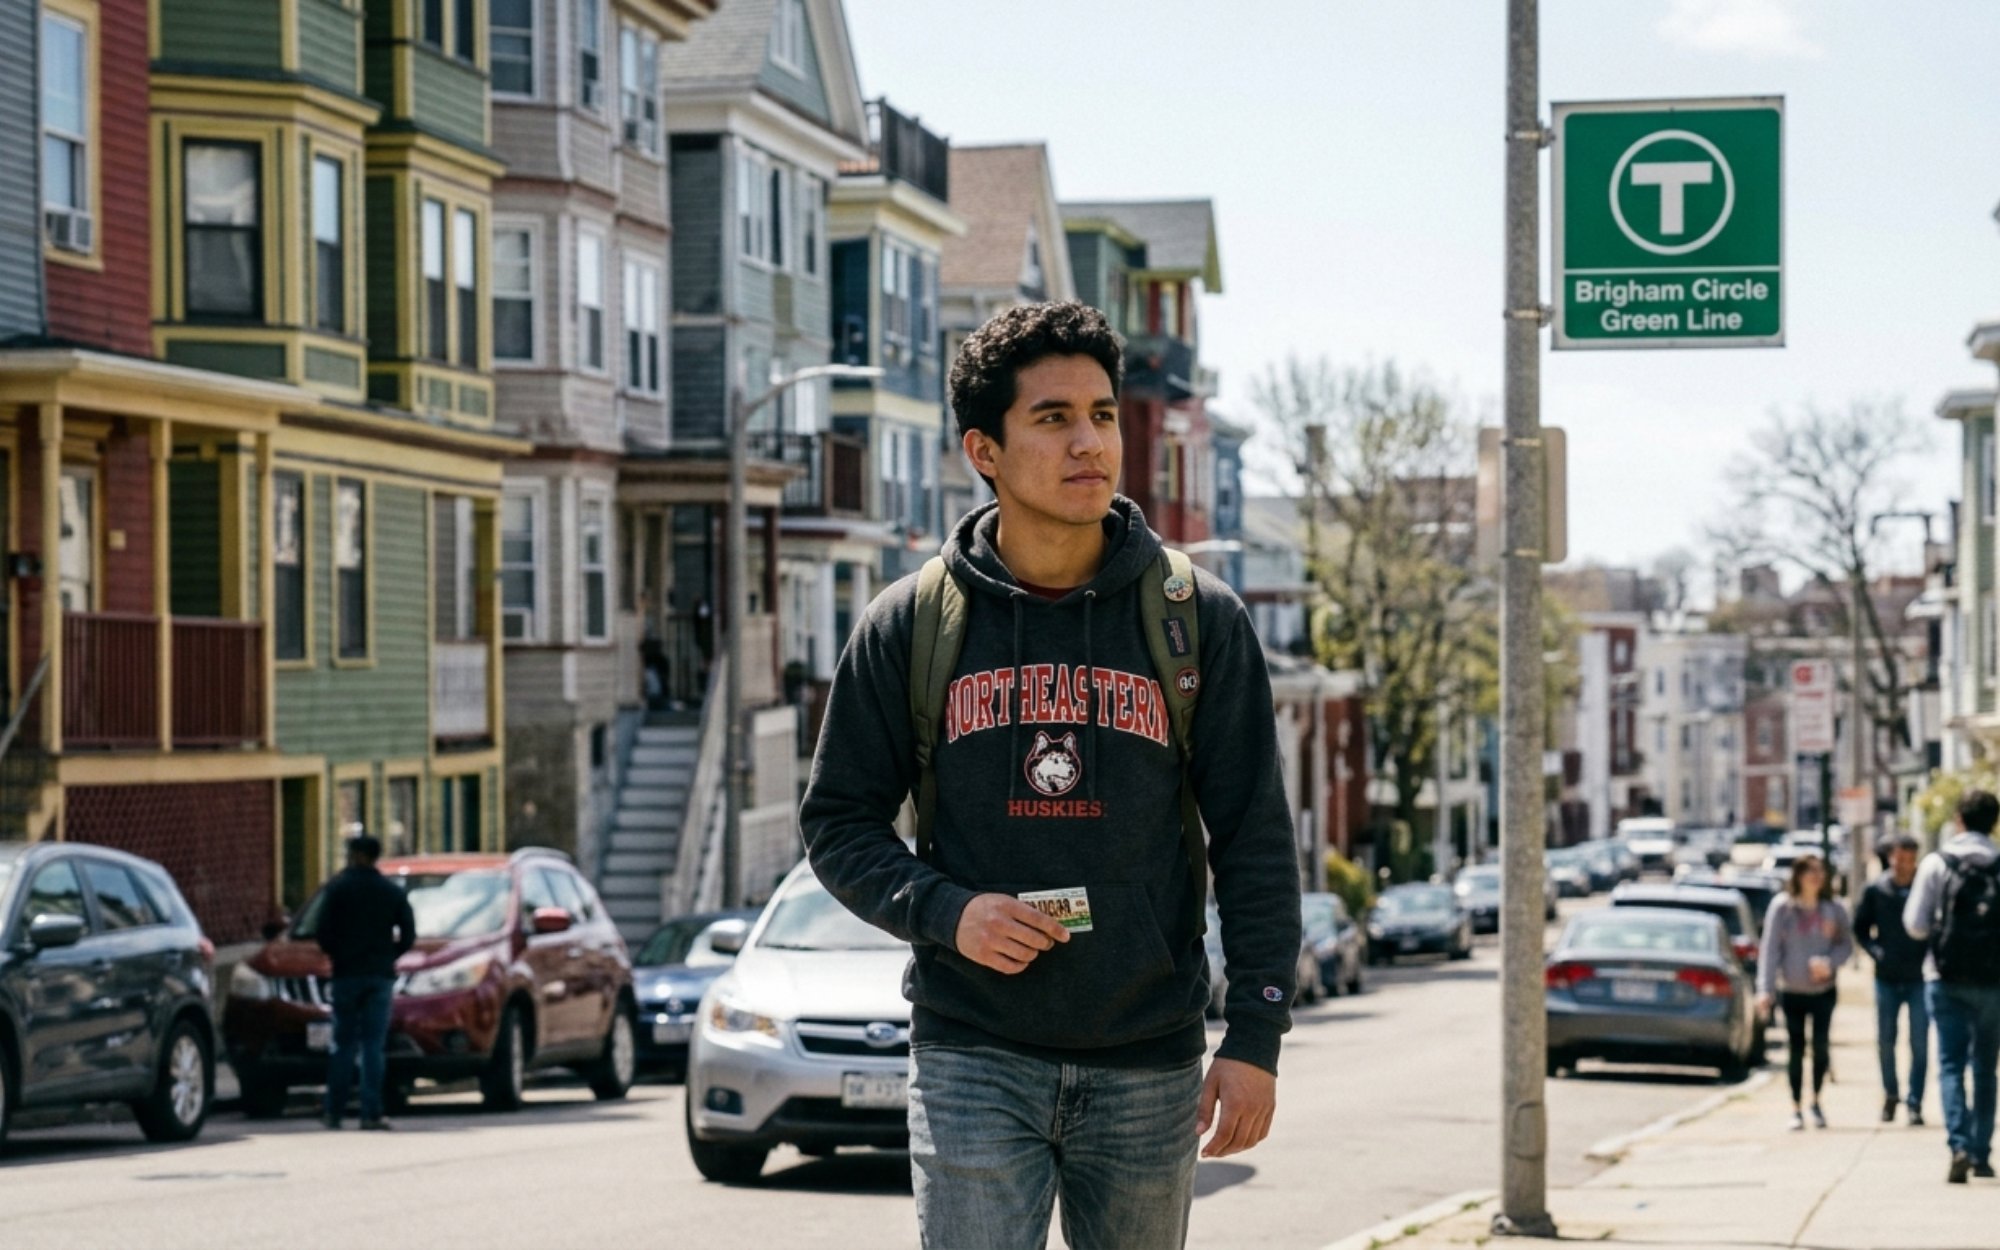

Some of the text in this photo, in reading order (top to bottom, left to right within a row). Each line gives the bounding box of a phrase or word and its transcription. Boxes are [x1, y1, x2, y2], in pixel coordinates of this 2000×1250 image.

[1631, 161, 1713, 235] T
[1575, 278, 1769, 307] Brigham Circle
[1600, 308, 1743, 331] Green Line
[1007, 799, 1102, 818] HUSKIES
